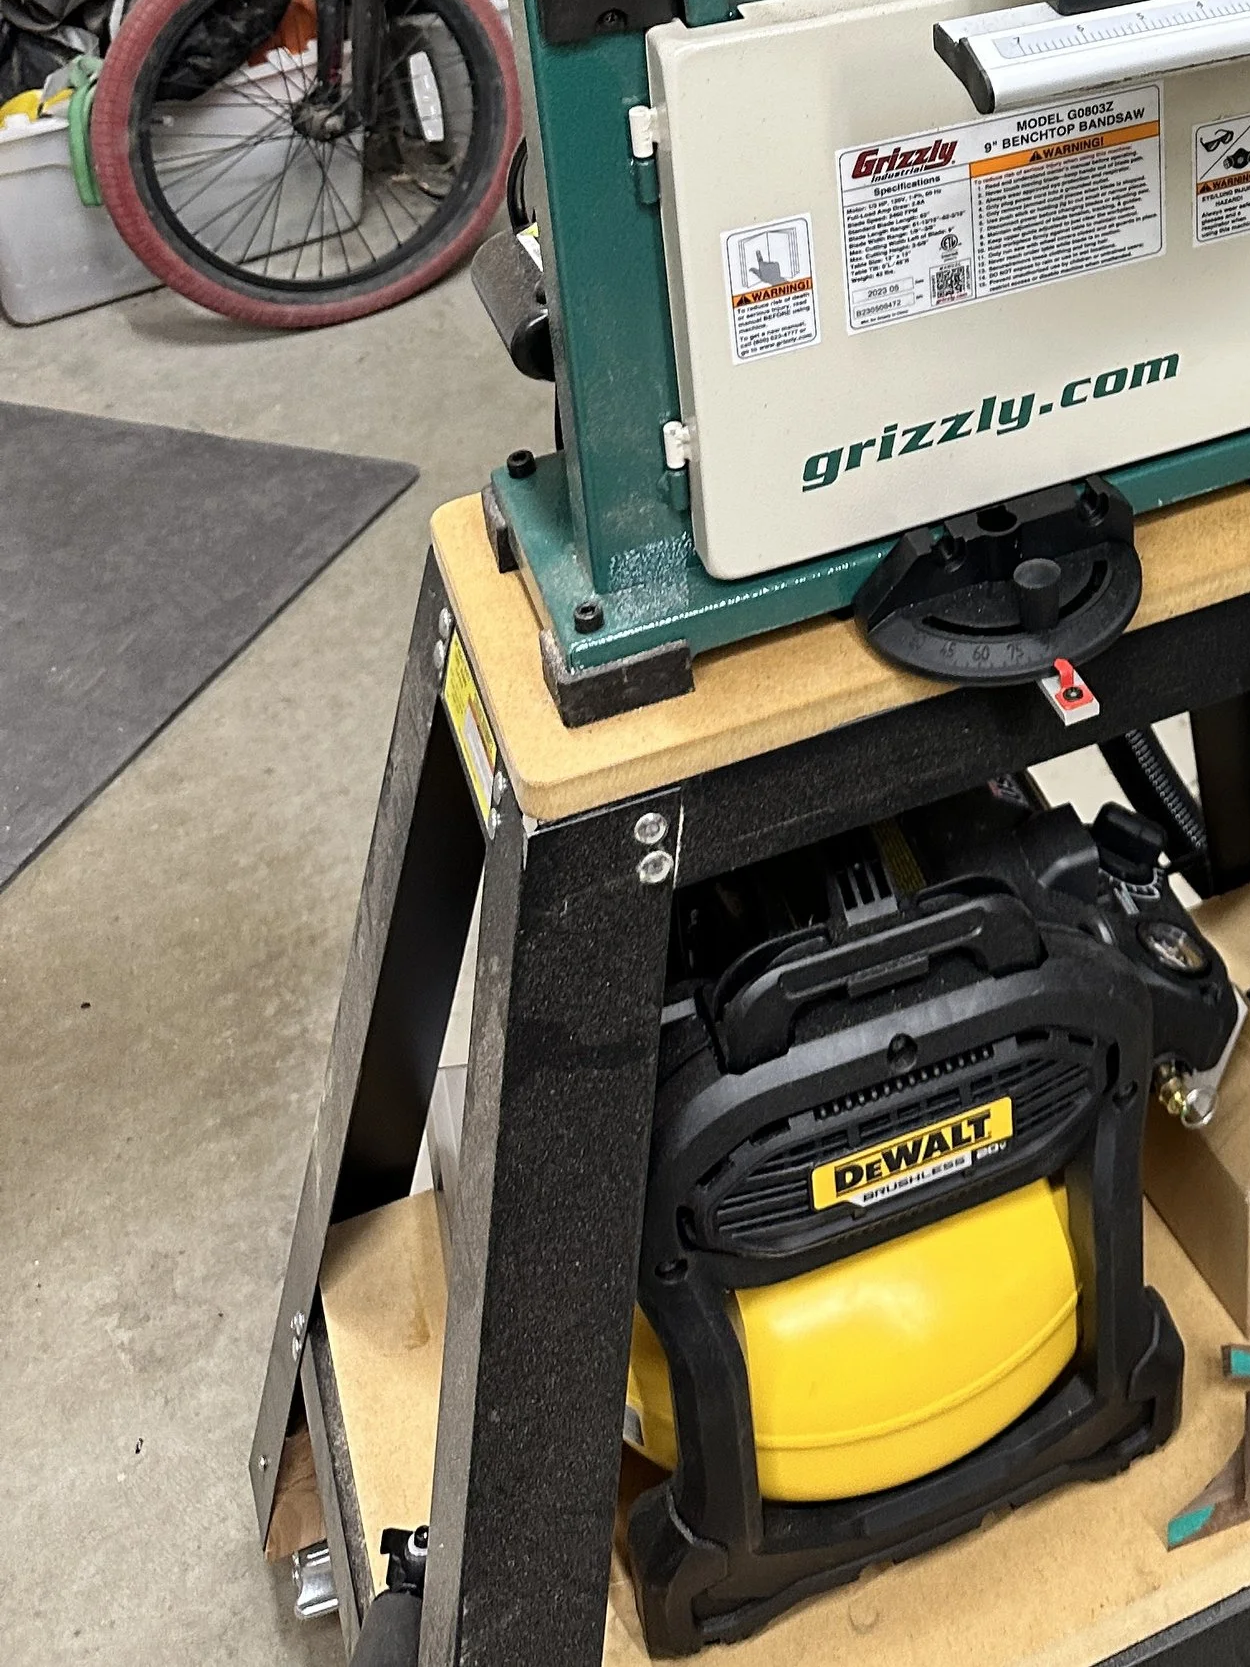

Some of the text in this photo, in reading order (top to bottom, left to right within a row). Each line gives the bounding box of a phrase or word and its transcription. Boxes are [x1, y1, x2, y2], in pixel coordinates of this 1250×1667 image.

[1017, 101, 1114, 132] MODEL G0803Z
[984, 108, 1145, 153] 9" BENCHTOP BANDSAW
[1042, 136, 1104, 158] WARNING!
[852, 139, 958, 179] Grizzly
[871, 165, 924, 183] Industrial
[874, 176, 940, 196] Specifications
[752, 280, 809, 301] WARNING!
[868, 287, 887, 298] 2023
[747, 301, 769, 312] reduce
[770, 298, 782, 306] risk
[792, 291, 809, 301] death
[802, 353, 1179, 492] grizzly.com
[972, 644, 990, 661] 60
[1007, 643, 1024, 659] 75
[863, 1157, 965, 1202] BRUSHLESS
